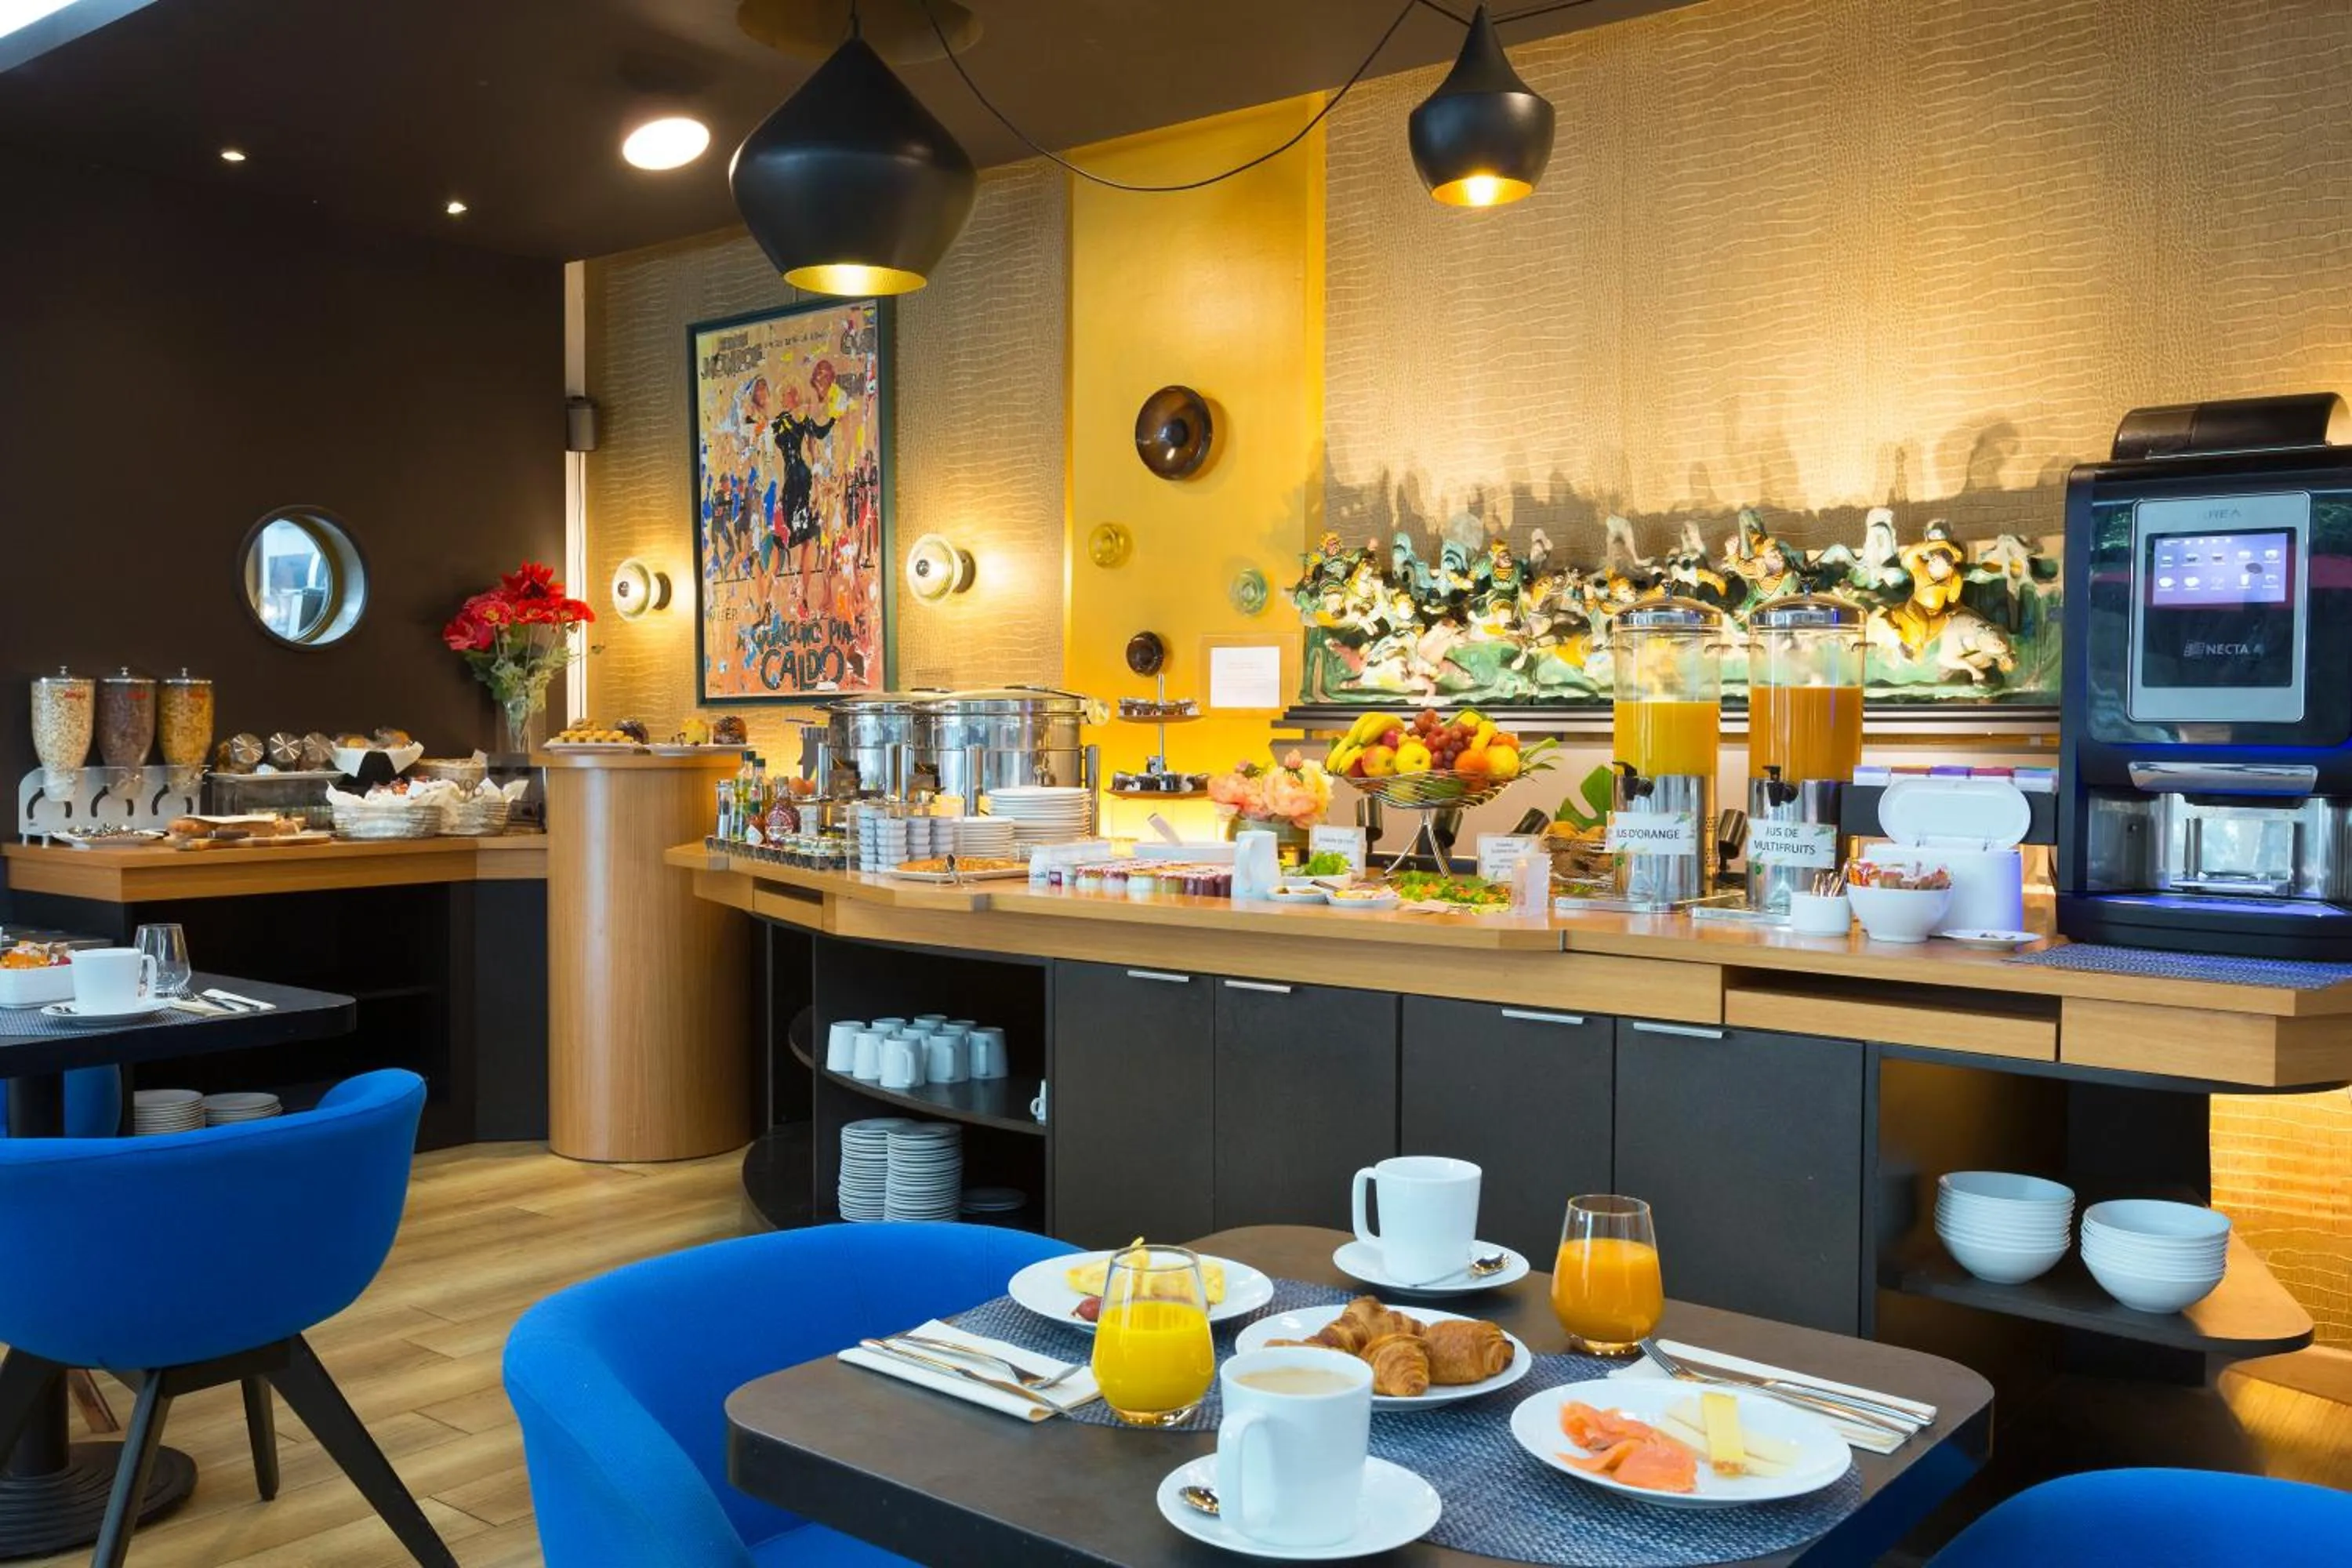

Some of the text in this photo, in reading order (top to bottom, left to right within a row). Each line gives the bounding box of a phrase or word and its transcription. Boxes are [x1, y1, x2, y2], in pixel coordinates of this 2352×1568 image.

[2205, 643, 2249, 655] NECTA
[760, 644, 844, 691] CALDO
[1628, 827, 1681, 840] D'ORANGE
[1766, 826, 1799, 838] JUS DE
[1754, 840, 1817, 855] MULTIFRUITS
